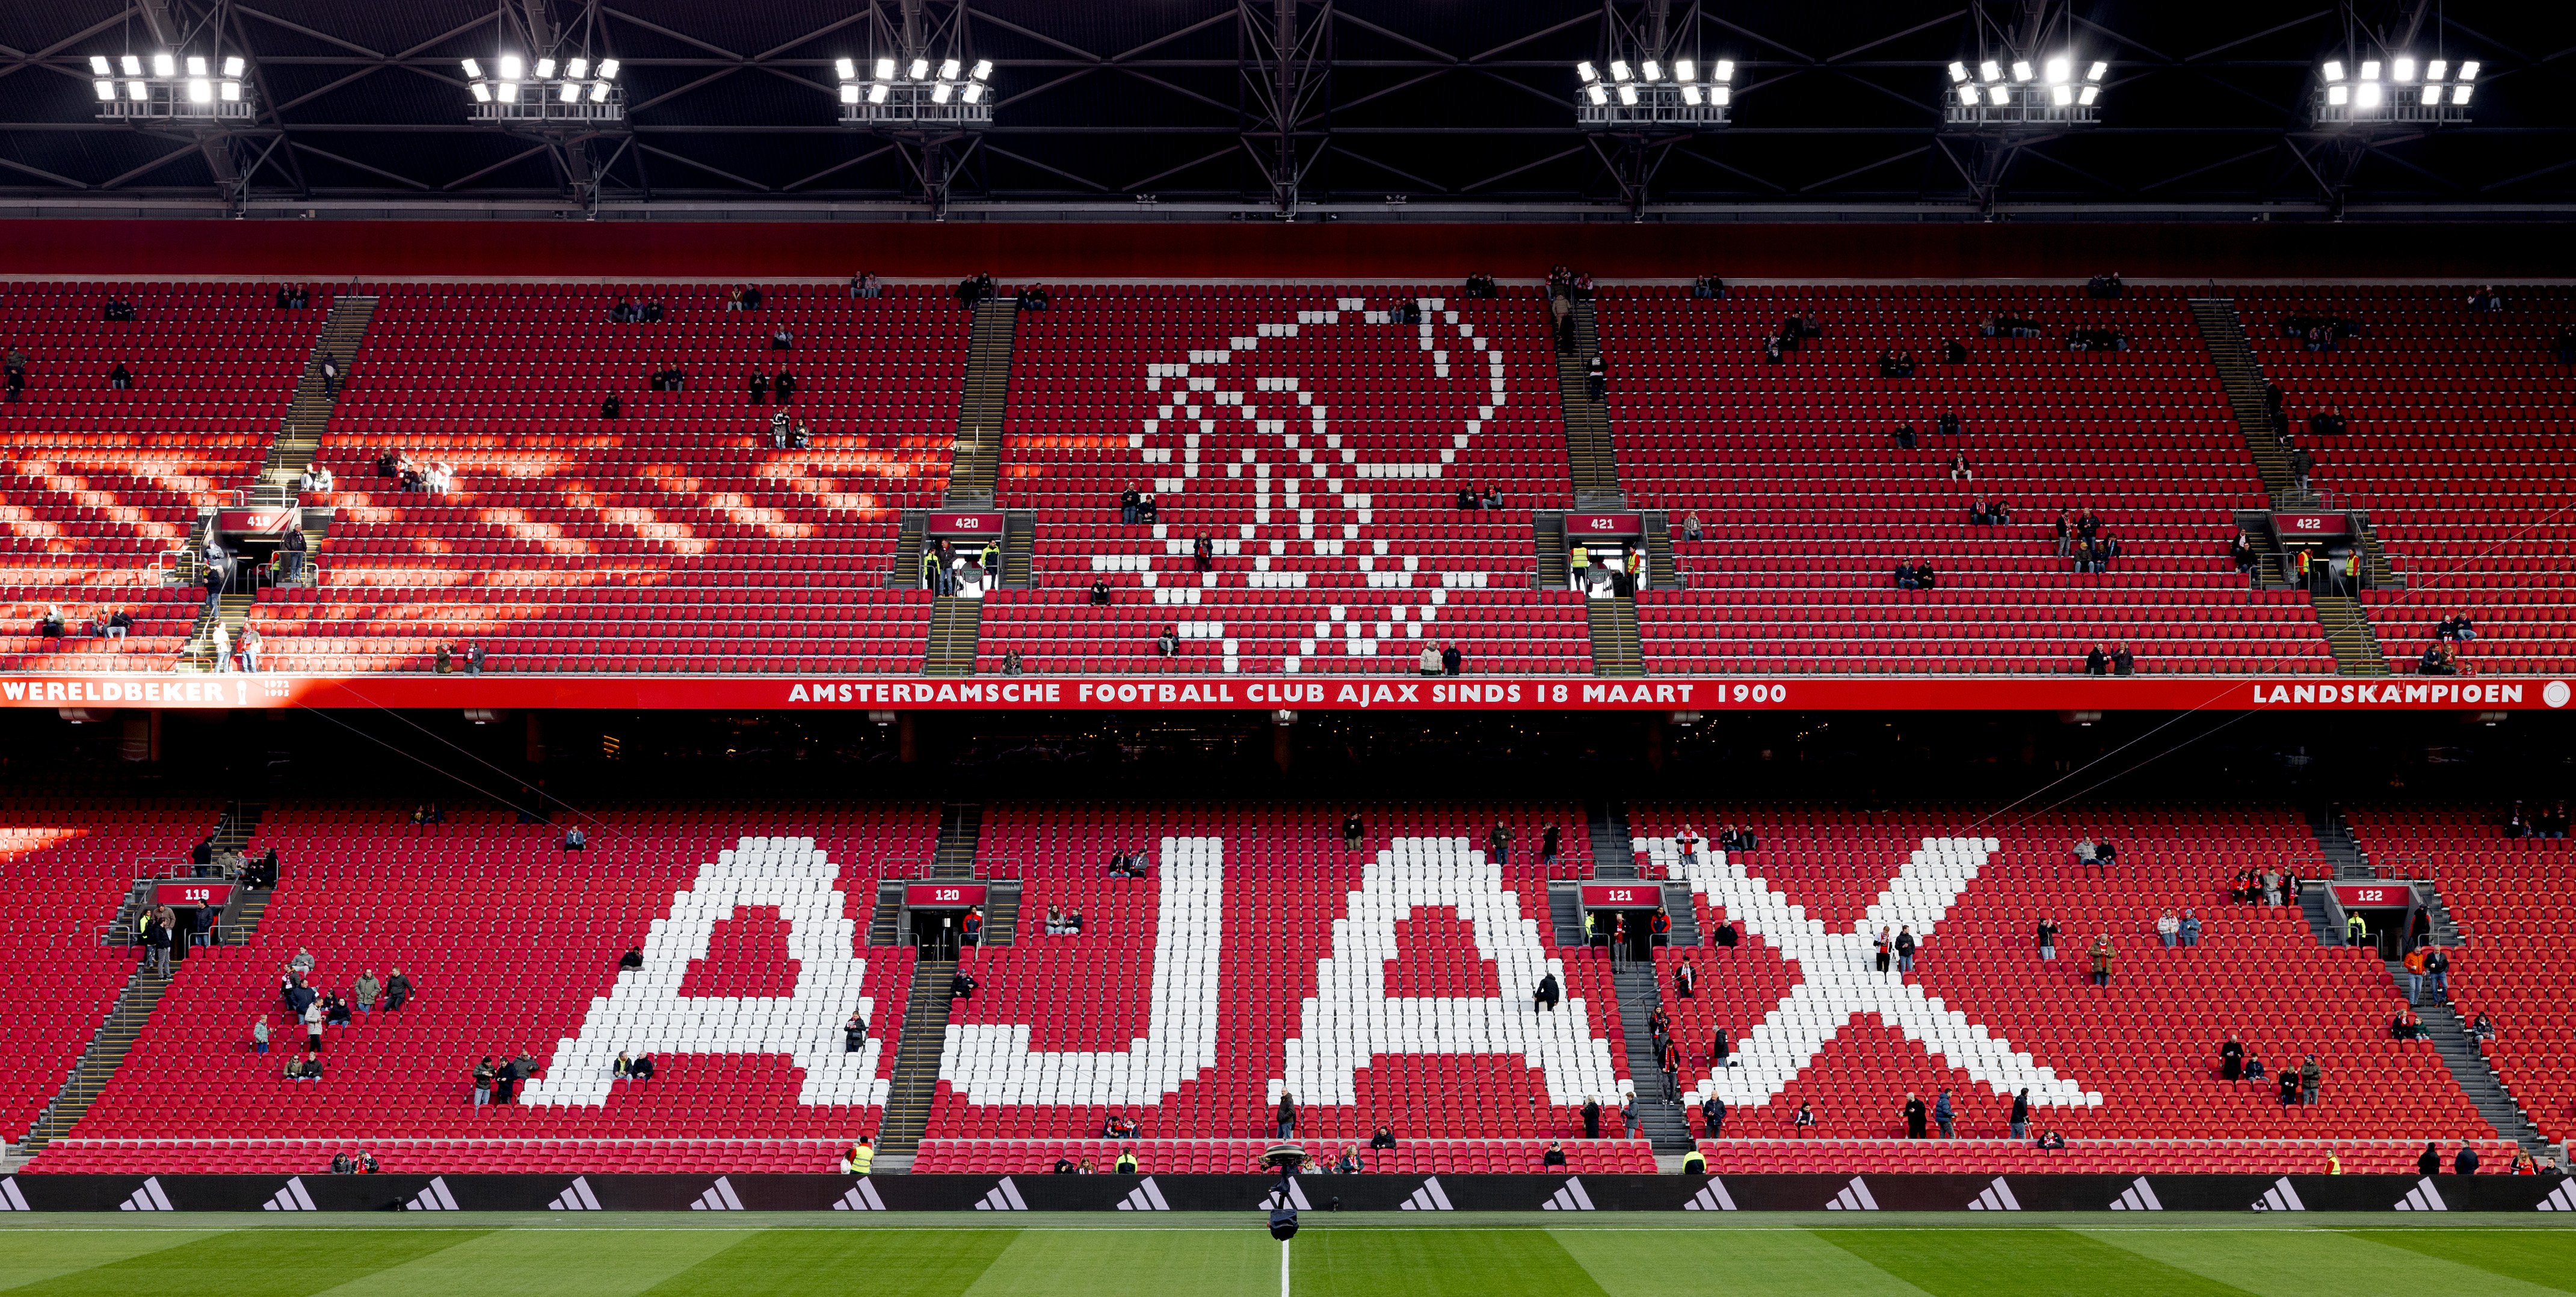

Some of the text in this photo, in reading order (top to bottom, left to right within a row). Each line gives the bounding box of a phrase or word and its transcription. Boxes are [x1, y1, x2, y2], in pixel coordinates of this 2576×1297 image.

[955, 518, 978, 528] 420
[1591, 519, 1614, 529] 421
[2297, 519, 2320, 529] 422
[2, 682, 224, 701] WERELDBEKER
[788, 683, 1786, 707] AMSTERDAMSCHE FOOTBALL CLUB AJAX SINDS 18 MAART 1900
[2254, 685, 2522, 703] LANDSKAMPIOEN
[185, 889, 209, 900] 119
[935, 889, 960, 901] 120
[1609, 890, 1633, 901] 121
[2358, 890, 2383, 901] 122
[519, 837, 2104, 1109] AJAX
